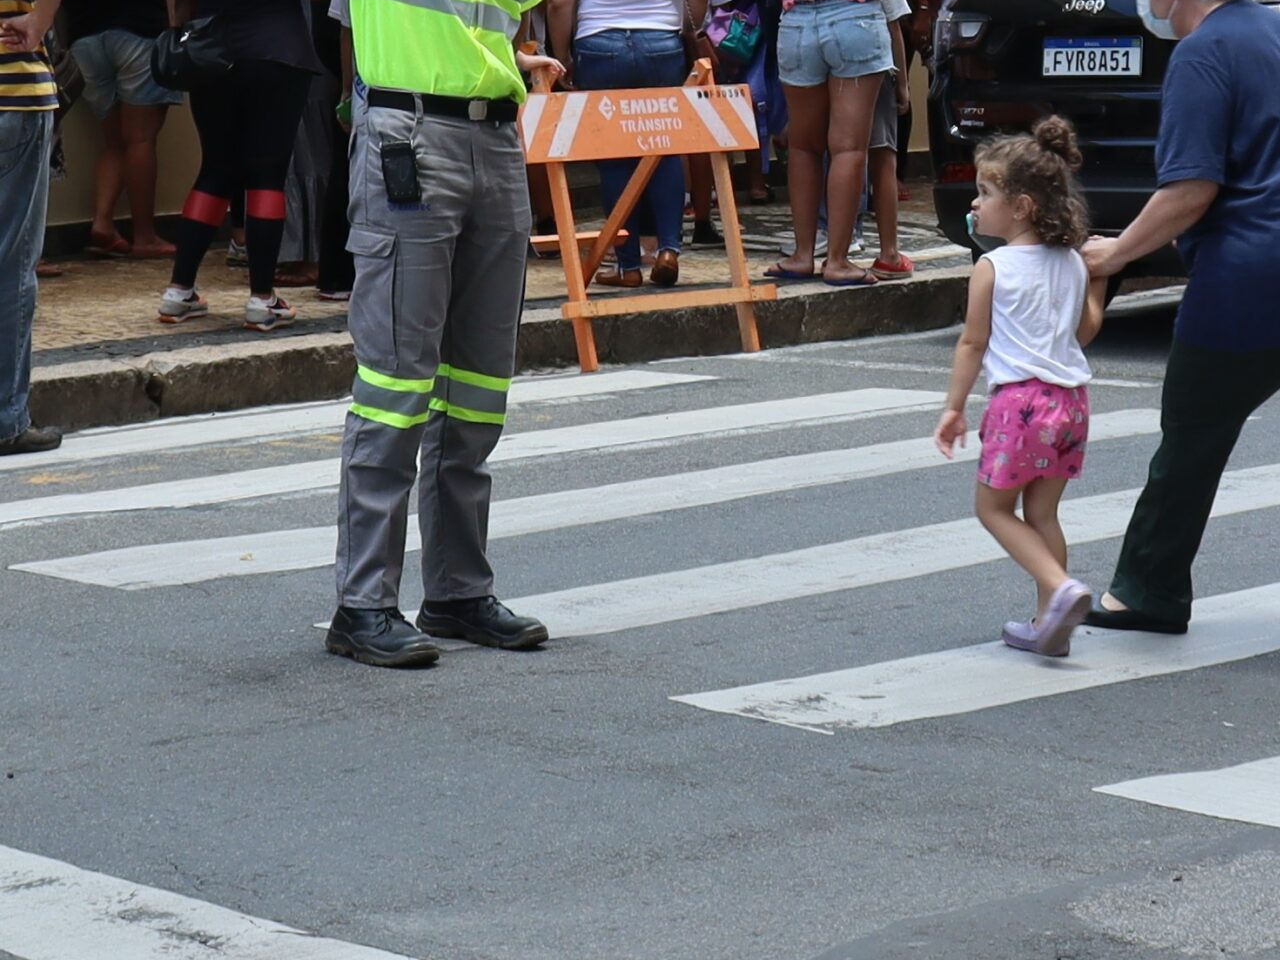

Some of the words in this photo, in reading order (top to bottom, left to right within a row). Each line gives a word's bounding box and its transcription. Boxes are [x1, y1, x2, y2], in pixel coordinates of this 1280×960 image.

[1053, 50, 1131, 72] FYR8A51
[619, 96, 679, 115] EMDEC
[620, 116, 682, 133] TRÂNSITO
